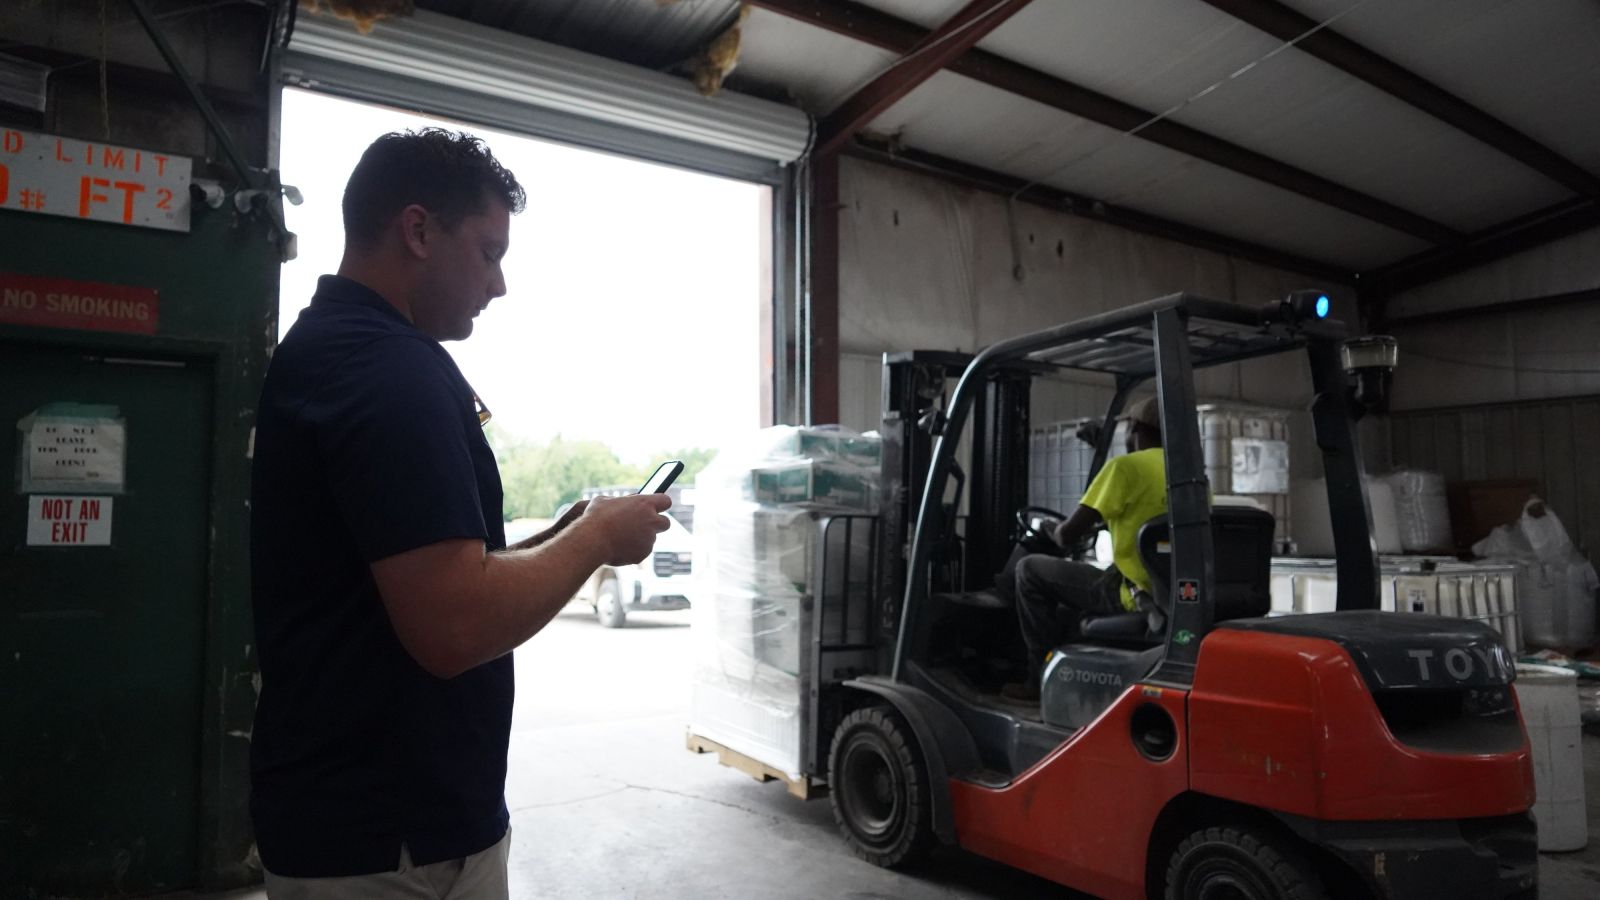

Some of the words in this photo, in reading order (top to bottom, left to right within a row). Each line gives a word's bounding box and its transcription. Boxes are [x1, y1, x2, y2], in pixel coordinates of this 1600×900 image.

[56, 138, 168, 176] LIMIT
[4, 288, 37, 310] NO
[46, 293, 149, 321] SMOKING
[41, 498, 73, 520] NOT
[79, 499, 100, 521] AN
[52, 522, 88, 543] EXIT
[1076, 669, 1122, 687] TOYOTA
